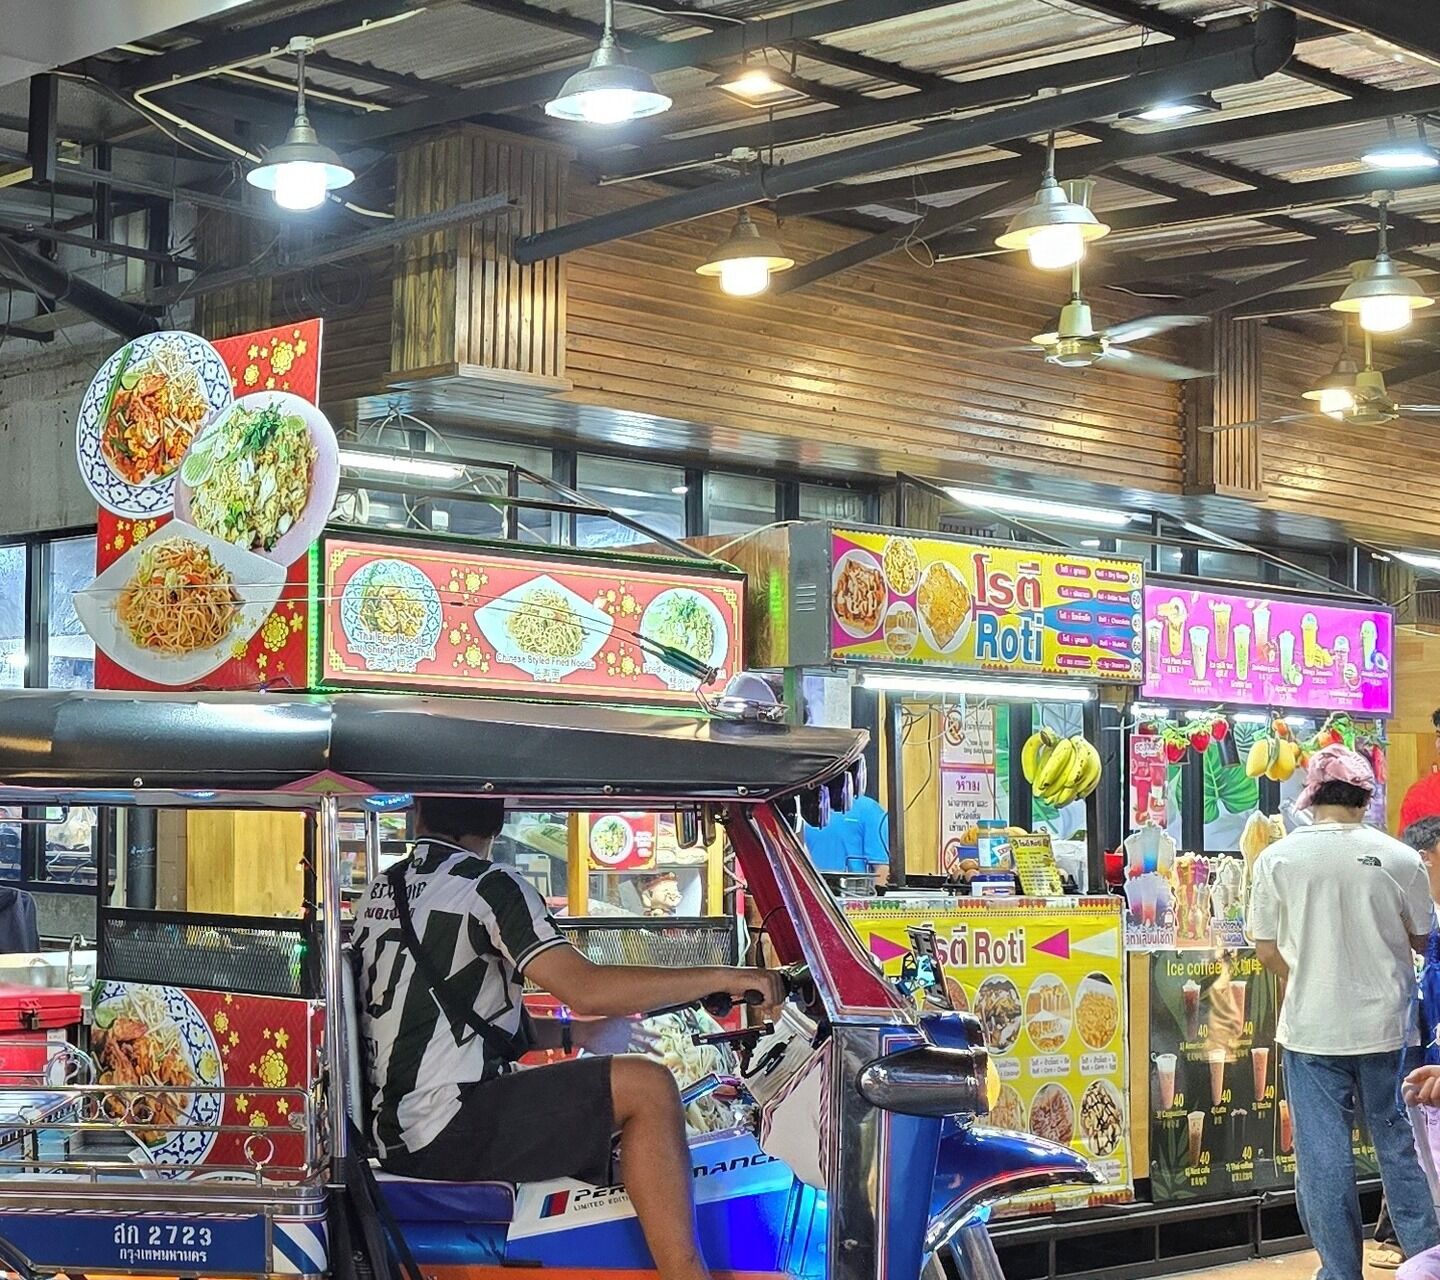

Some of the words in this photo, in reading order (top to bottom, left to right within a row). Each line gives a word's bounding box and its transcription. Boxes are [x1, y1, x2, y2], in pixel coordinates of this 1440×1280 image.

[972, 553, 1043, 610] โรตี
[975, 613, 1043, 663] Roti
[955, 775, 980, 791] ห้าม
[974, 928, 1025, 966] Roti
[1166, 960, 1185, 976] Ice
[1186, 959, 1222, 976] coffee
[1197, 1023, 1208, 1037] 40
[1243, 1021, 1254, 1035] 40
[1173, 1093, 1184, 1107] 40
[1221, 1088, 1231, 1103] 40
[1264, 1085, 1274, 1099] 40
[1199, 1151, 1211, 1165] 40
[1241, 1146, 1253, 1160] 40
[573, 1199, 605, 1212] LIMITED
[608, 1195, 629, 1206] EDITI
[114, 1222, 140, 1244] สก
[148, 1225, 213, 1246] 2723
[119, 1248, 208, 1264] กรุงเทพมหานคร
